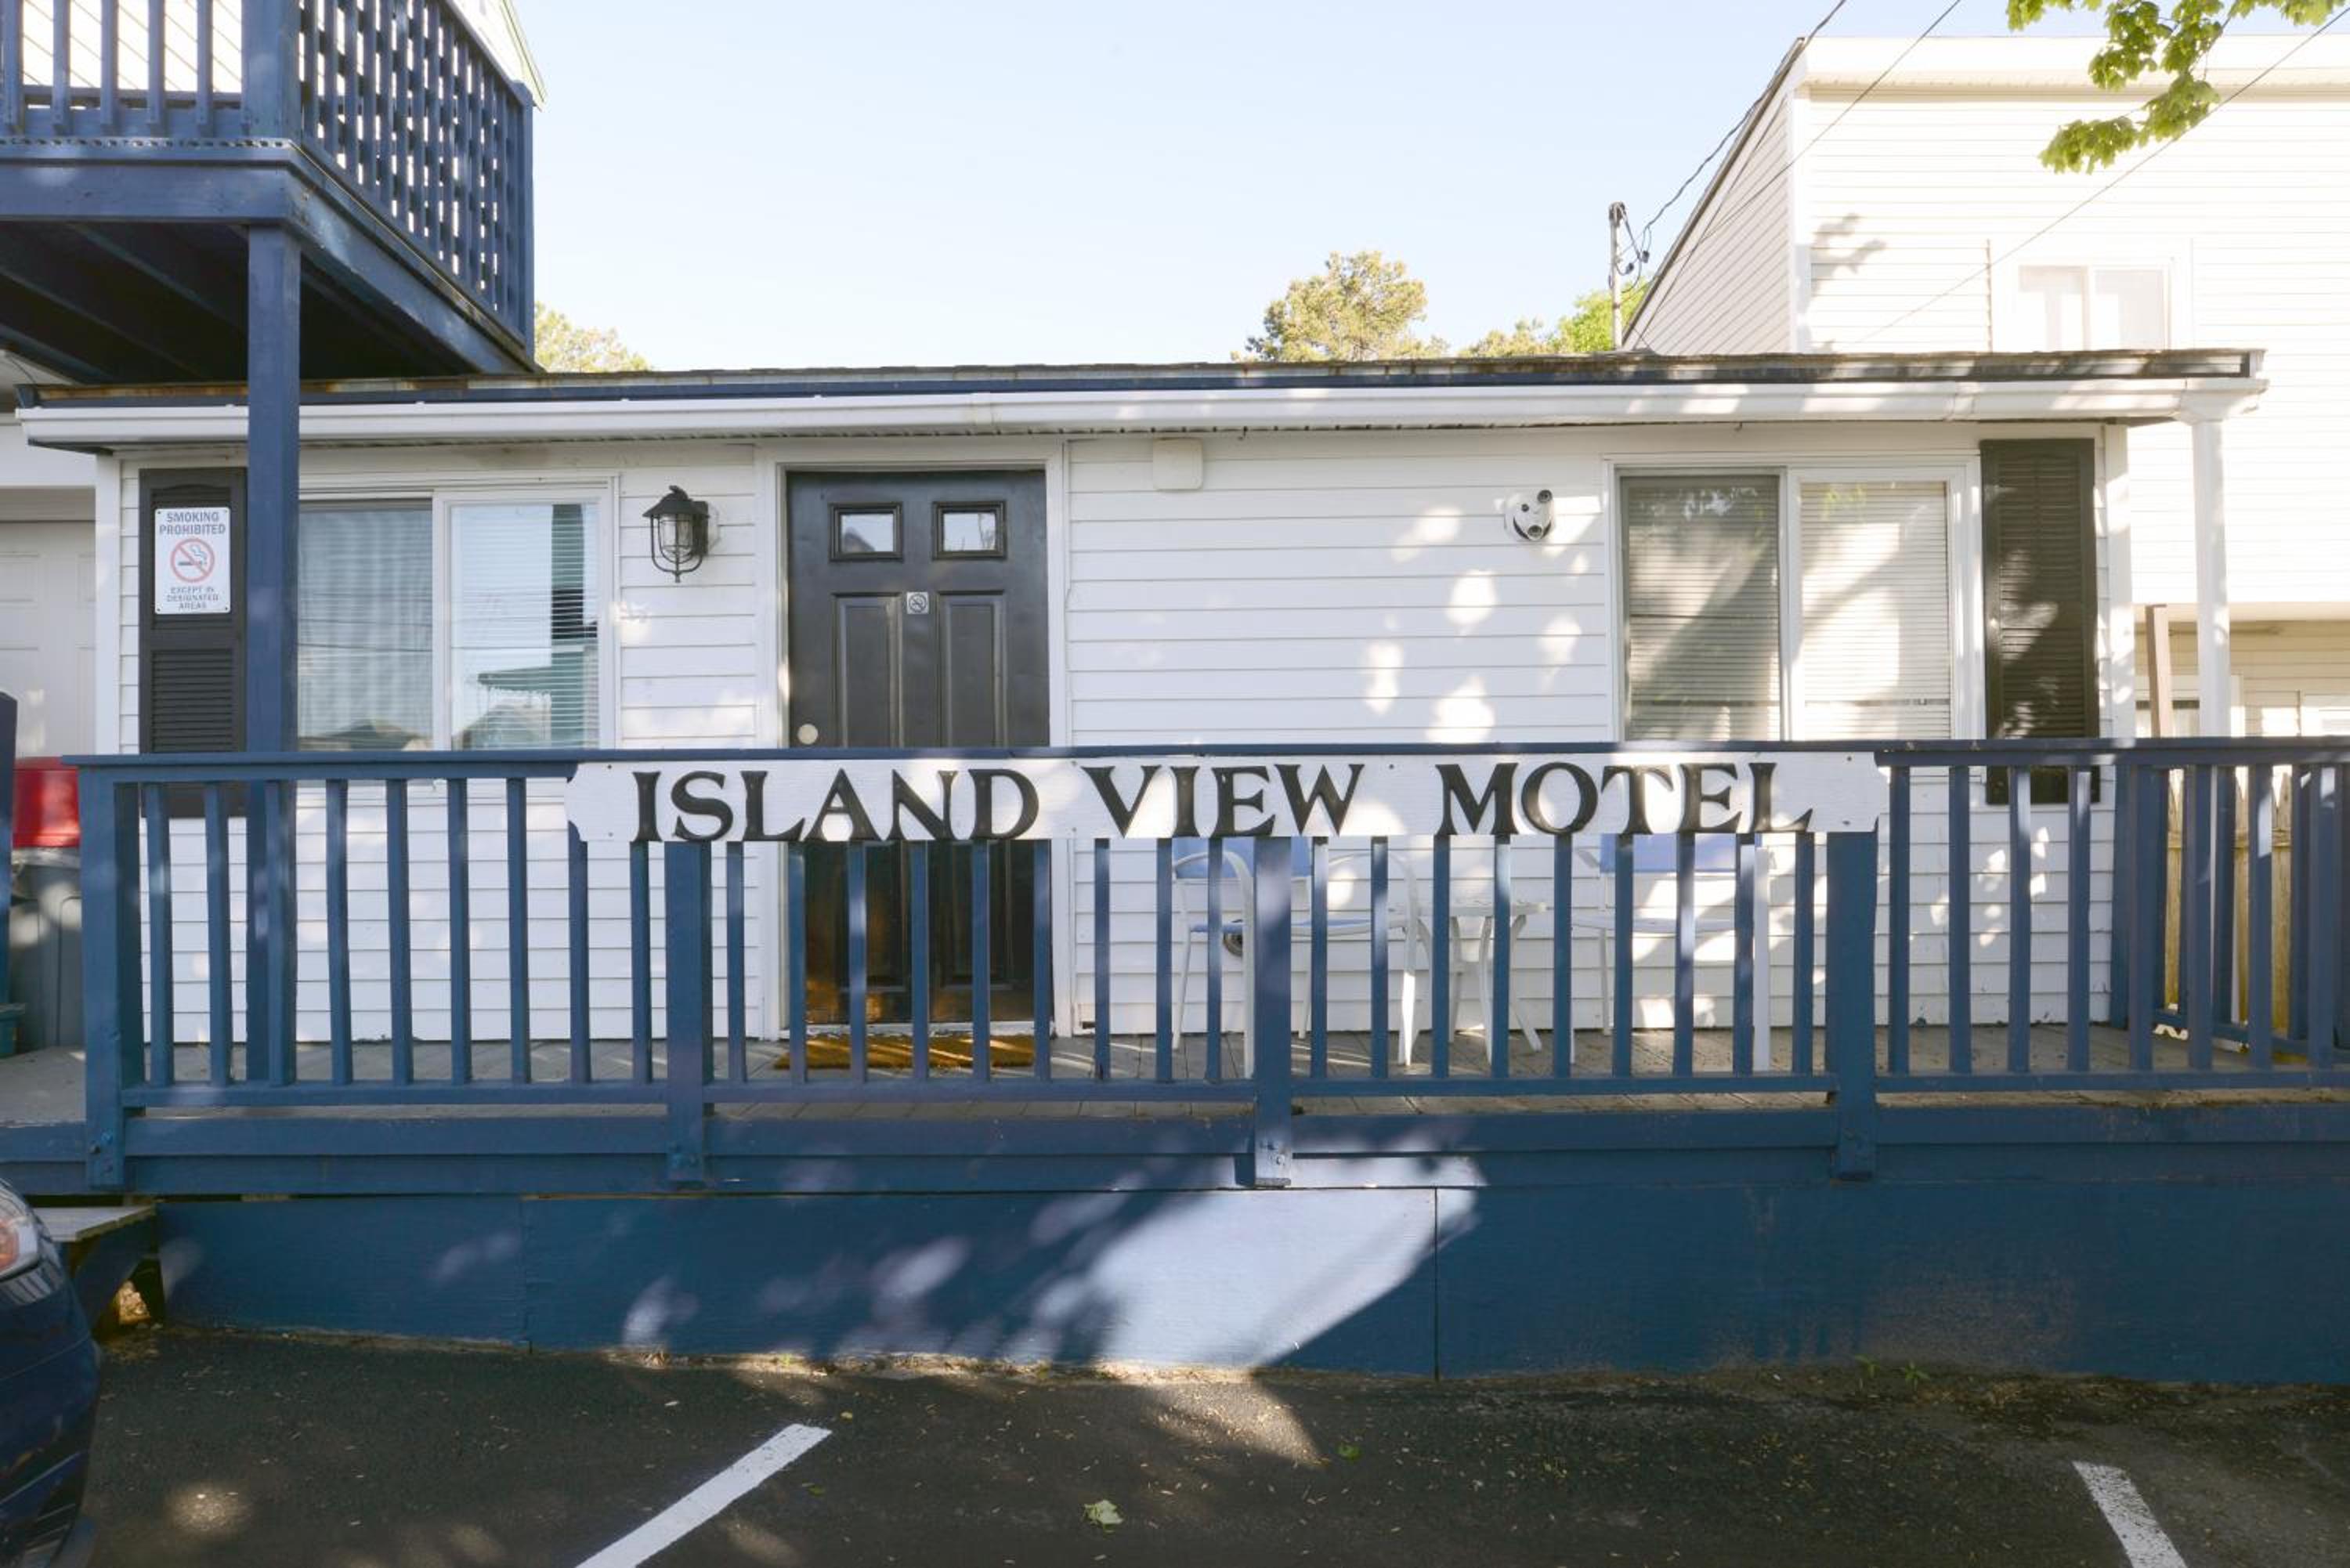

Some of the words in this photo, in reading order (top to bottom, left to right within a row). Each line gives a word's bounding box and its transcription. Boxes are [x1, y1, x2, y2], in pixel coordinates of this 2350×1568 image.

[166, 511, 219, 523] SMOKING
[159, 524, 226, 535] PROHIBITED
[631, 767, 1039, 842] ISLAND
[1080, 763, 1366, 839] VIEW
[1434, 761, 1814, 836] MOTEL
